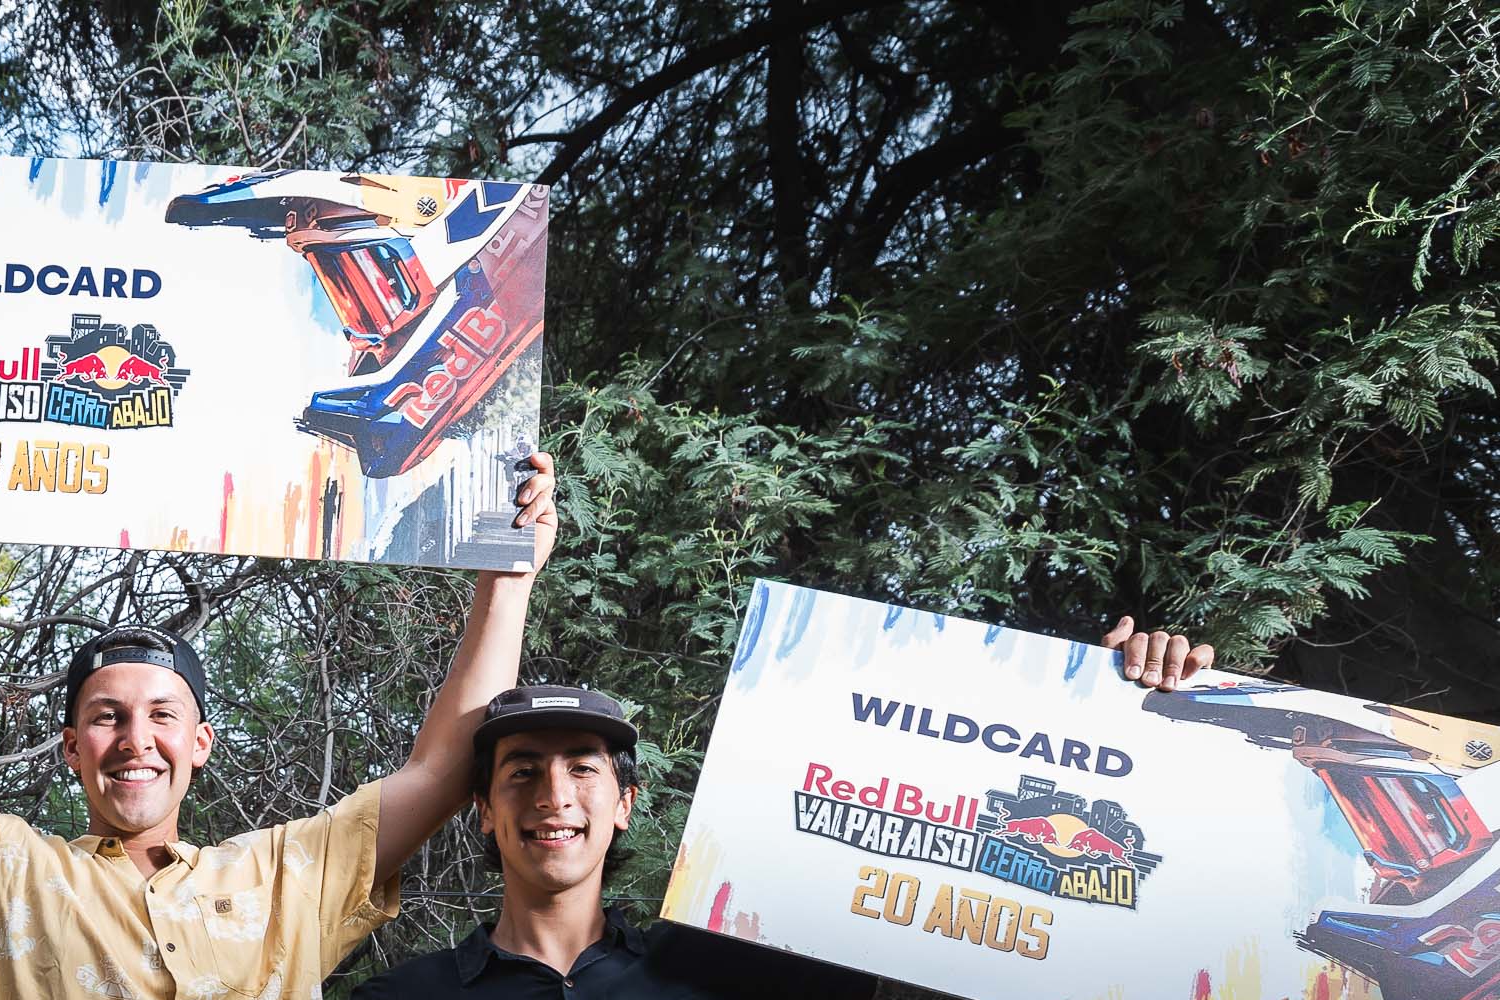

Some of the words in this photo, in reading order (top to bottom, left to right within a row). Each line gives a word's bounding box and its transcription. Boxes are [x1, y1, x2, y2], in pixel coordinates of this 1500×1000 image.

[48, 386, 108, 427] CERRO
[112, 389, 170, 427] ABAJO
[8, 439, 110, 494] AÑOS
[852, 692, 1133, 778] WILDCARD
[803, 763, 889, 809] Red
[893, 783, 978, 830] Bull
[799, 794, 974, 868] VALPARAISO
[980, 839, 1053, 893] CERRO
[1059, 867, 1132, 906] ABAJO
[850, 865, 920, 927] 20
[923, 884, 1054, 961] AÑOS
